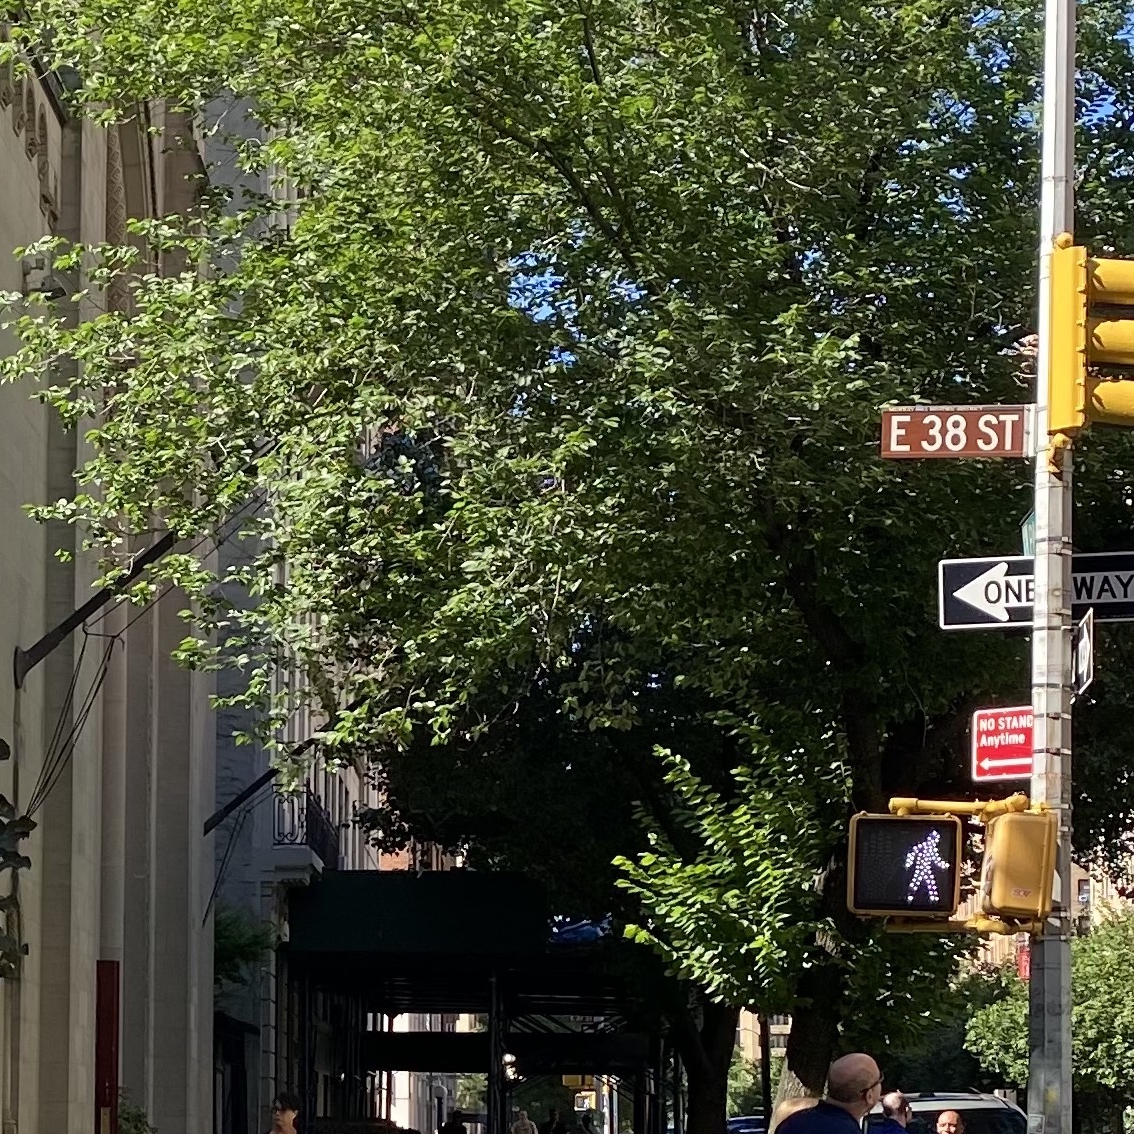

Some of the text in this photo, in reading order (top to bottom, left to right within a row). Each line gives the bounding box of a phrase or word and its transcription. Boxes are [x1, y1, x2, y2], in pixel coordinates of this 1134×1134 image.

[890, 413, 1020, 452] E 38 ST
[984, 574, 1134, 605] ONE WAY
[979, 717, 996, 732] NO
[979, 731, 1026, 749] Anytime
